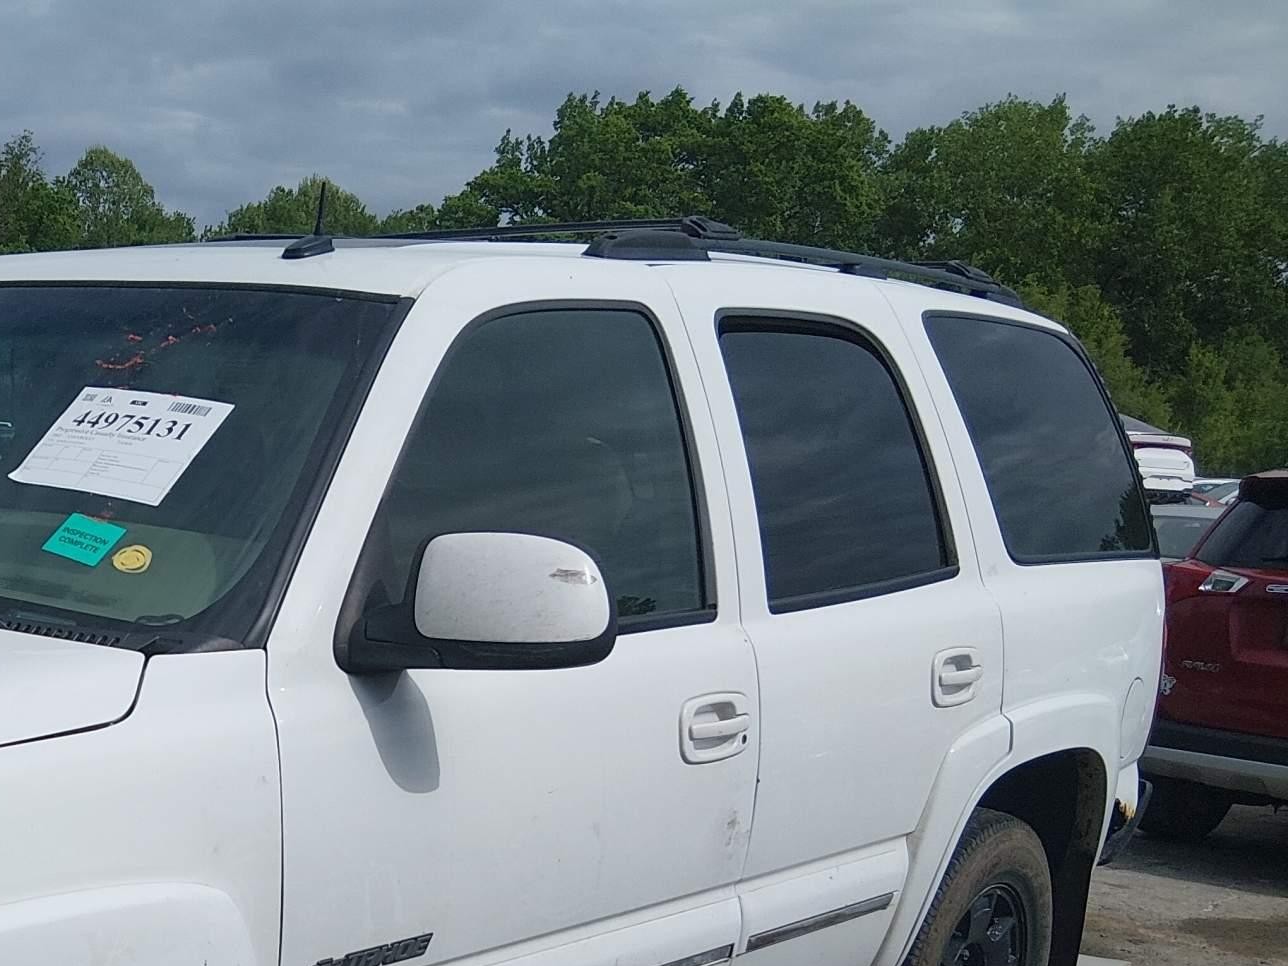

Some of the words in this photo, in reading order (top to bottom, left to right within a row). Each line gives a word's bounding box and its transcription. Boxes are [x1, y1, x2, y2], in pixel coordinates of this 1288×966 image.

[73, 410, 192, 440] 44975131
[58, 535, 101, 554] COMPLETE
[62, 526, 110, 546] INSPECTION
